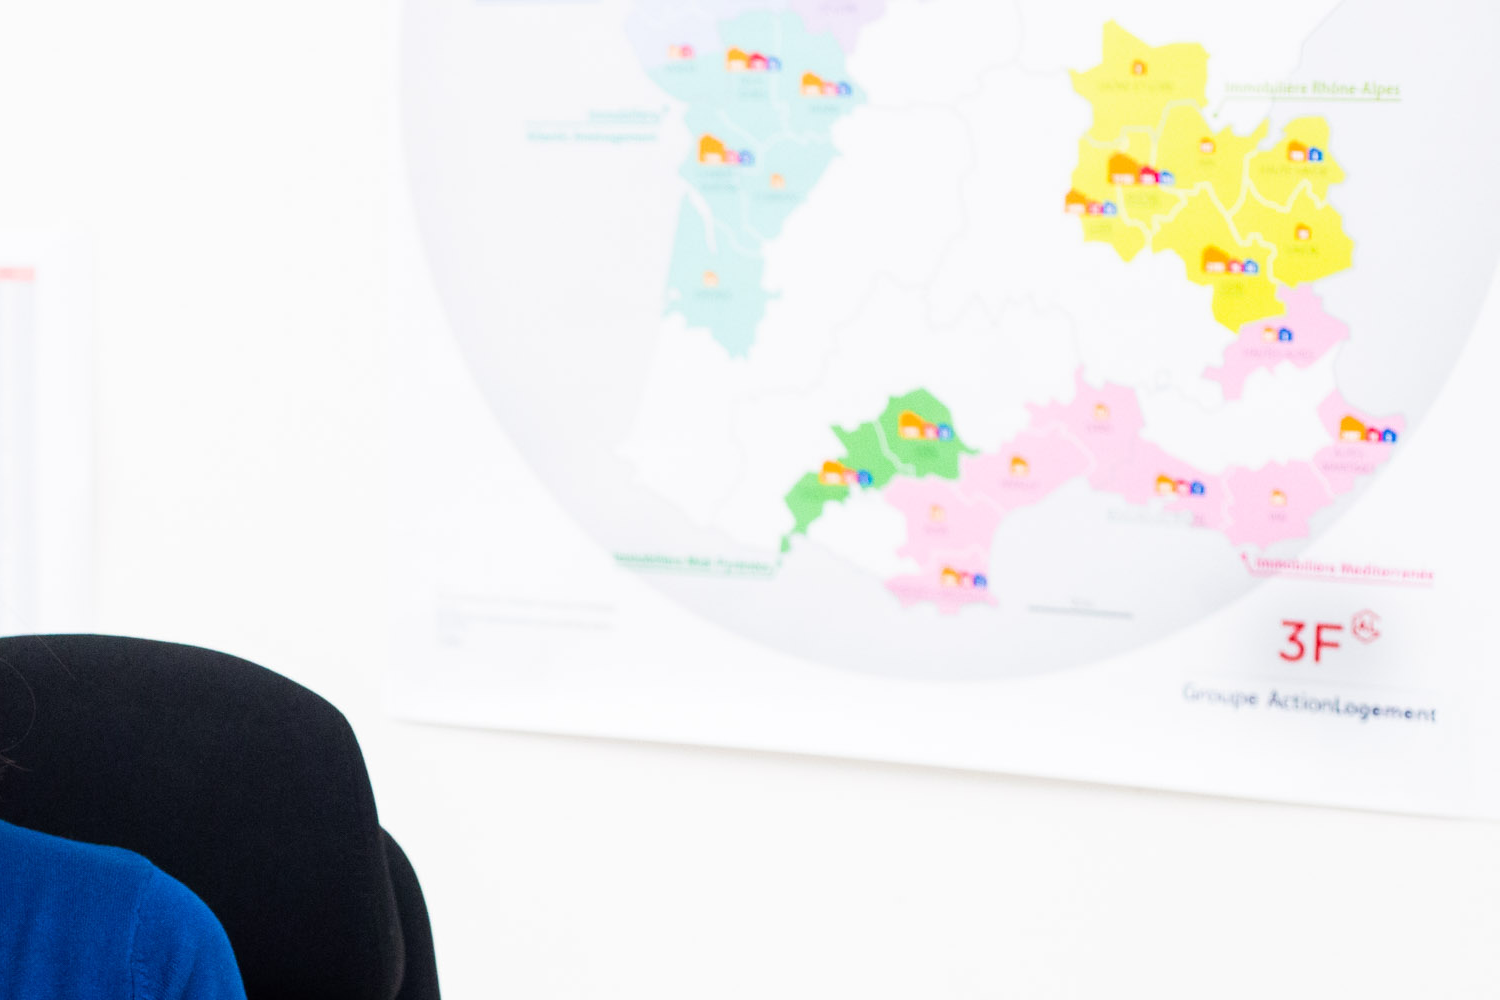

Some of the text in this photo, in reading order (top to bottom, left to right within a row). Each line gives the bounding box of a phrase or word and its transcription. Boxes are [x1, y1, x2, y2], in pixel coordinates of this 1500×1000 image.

[1278, 620, 1344, 663] 3F
[1182, 682, 1438, 723] Groupe ActionLogement
